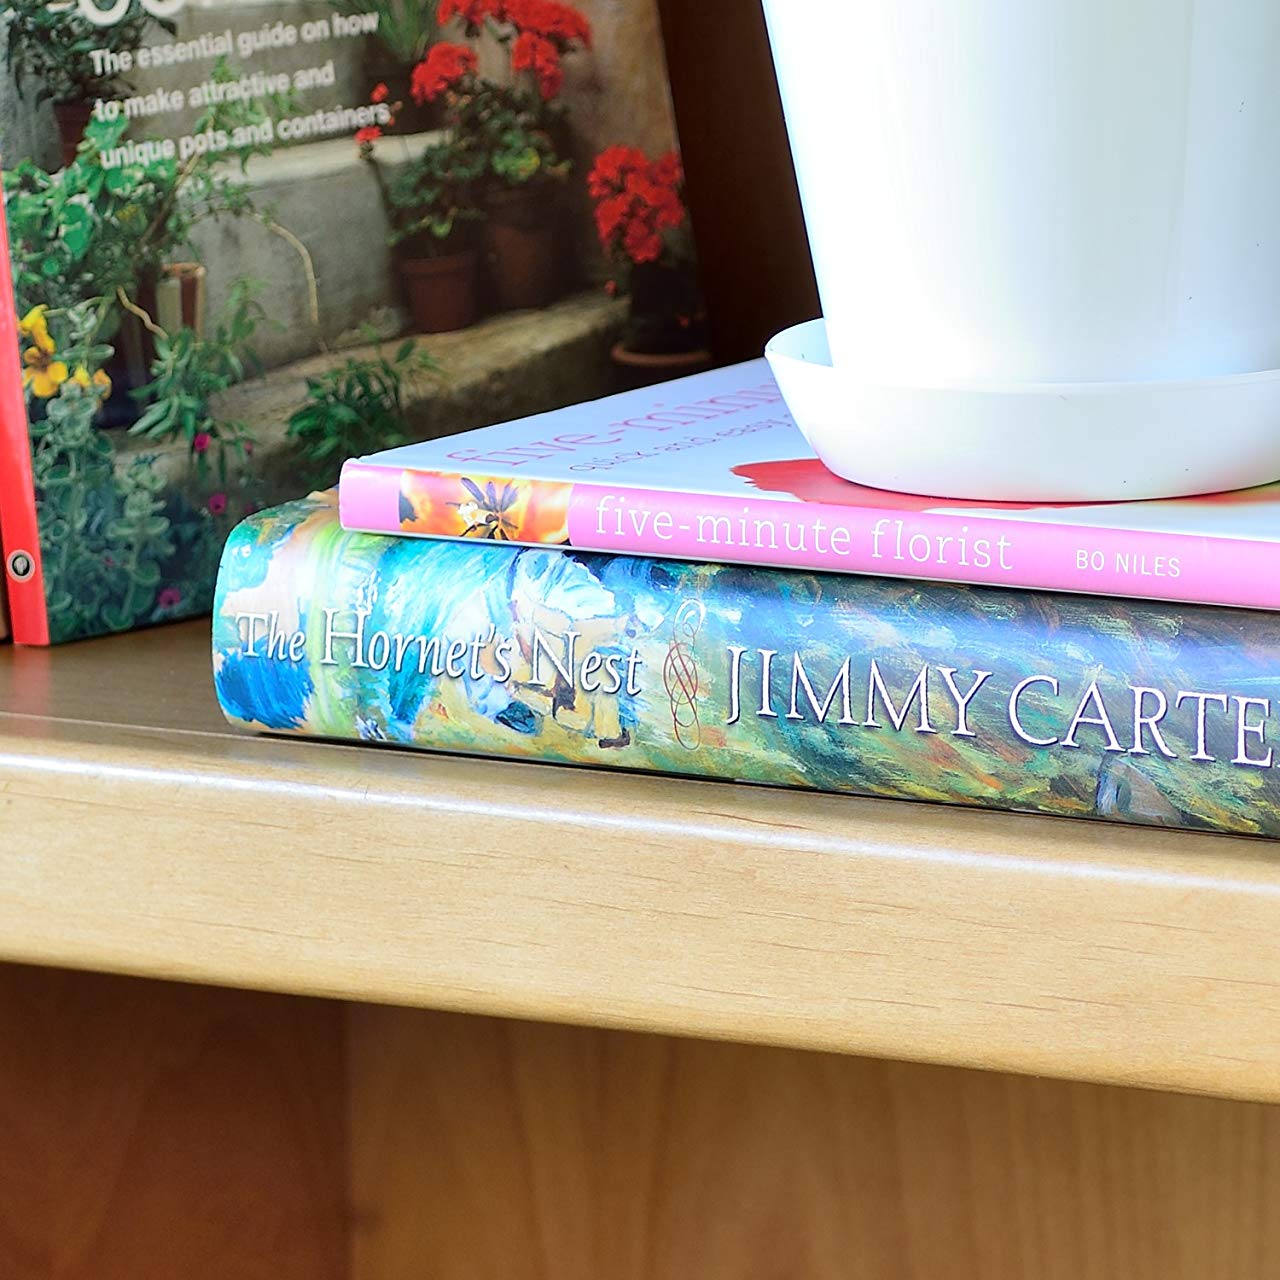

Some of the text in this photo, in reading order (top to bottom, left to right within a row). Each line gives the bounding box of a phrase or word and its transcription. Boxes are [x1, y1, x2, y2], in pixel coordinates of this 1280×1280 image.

[89, 10, 380, 76] The essential guide on how
[95, 59, 336, 123] to make attractive and
[100, 102, 392, 169] unique pots and containers
[595, 496, 1014, 573] five-minute florist
[1075, 547, 1182, 579] BO NILES
[236, 607, 643, 697] The Hornet's Nest
[728, 645, 991, 738] JIMMY
